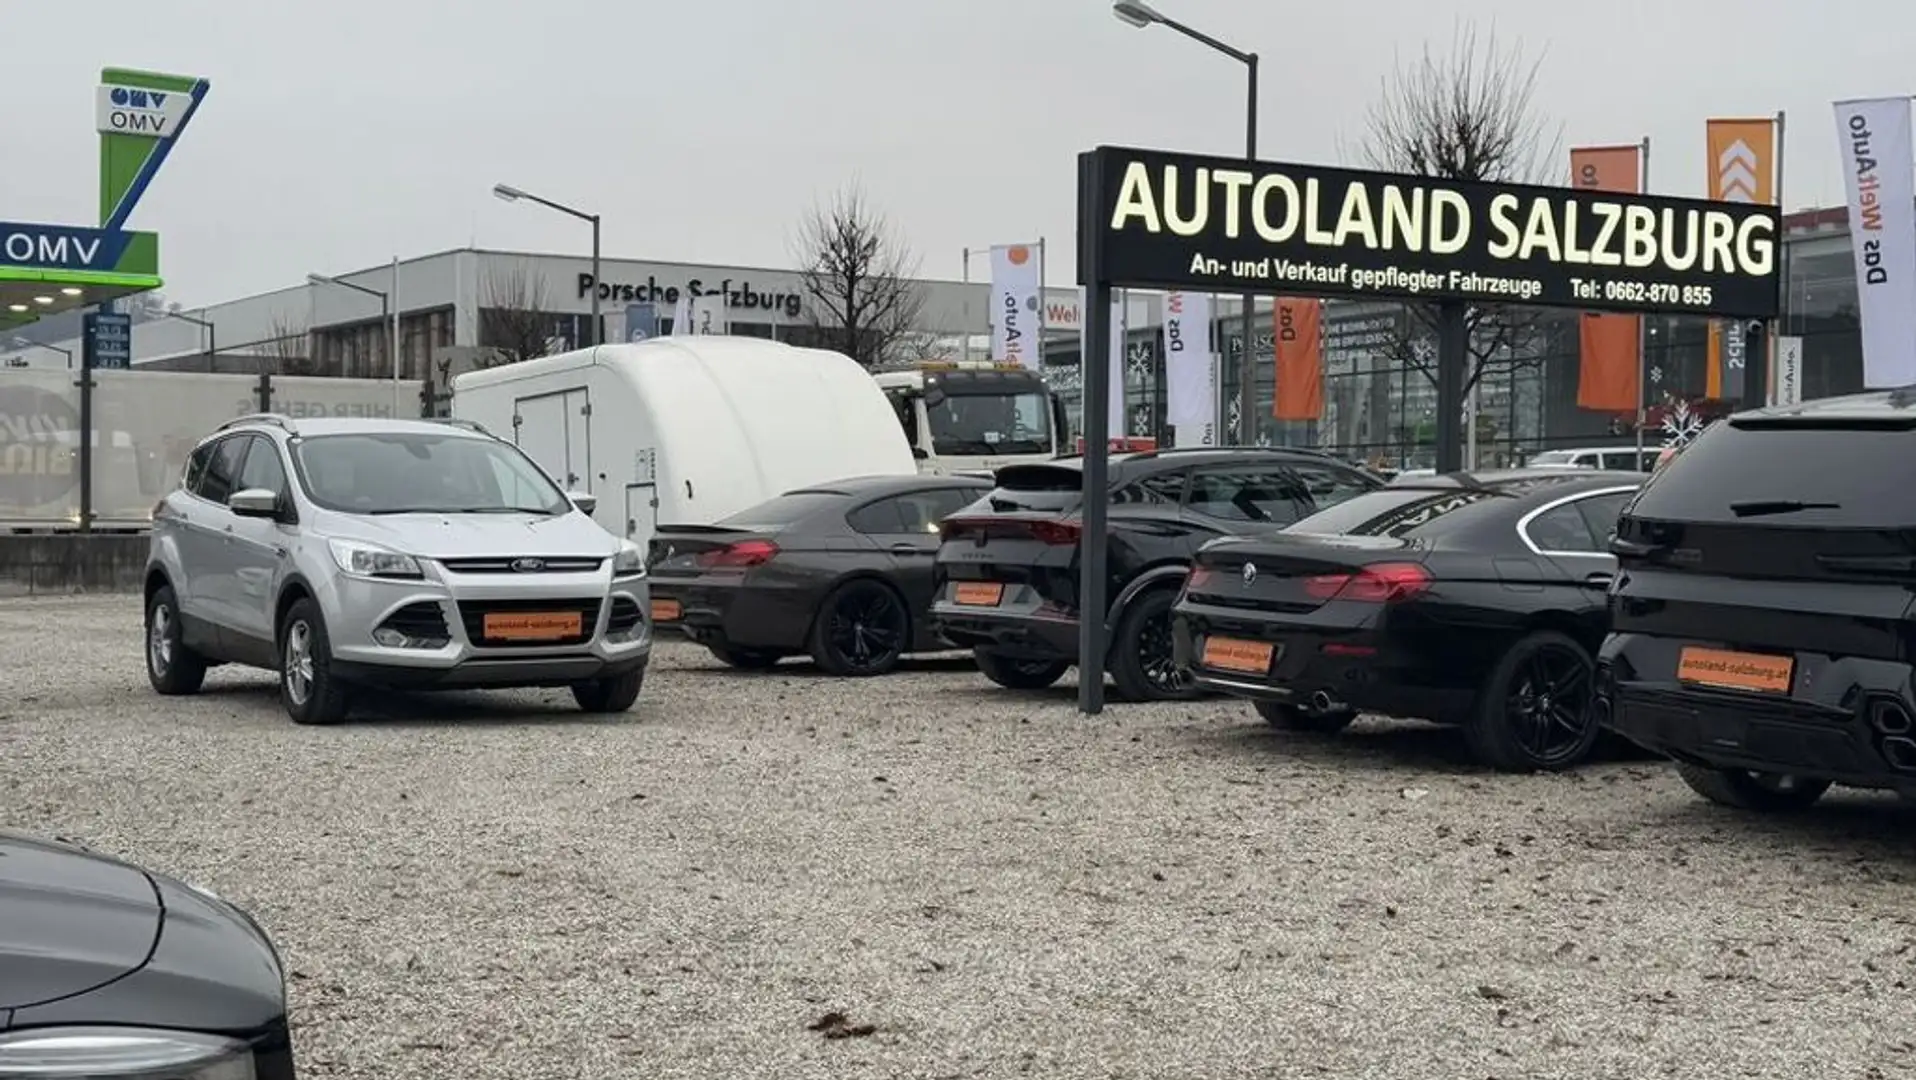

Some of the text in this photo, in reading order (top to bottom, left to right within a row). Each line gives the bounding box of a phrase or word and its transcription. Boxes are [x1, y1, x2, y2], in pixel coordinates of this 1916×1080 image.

[110, 111, 167, 133] OMV
[1111, 161, 1774, 276] AUTOLAND SALZBURG
[4, 232, 102, 266] OMV
[578, 273, 679, 304] Porsche
[1190, 253, 1712, 305] An- und Verkauf gepflegter Fahrzeuge Tel: 0662-870 855
[1682, 658, 1788, 681] autoland-salzburg.at
